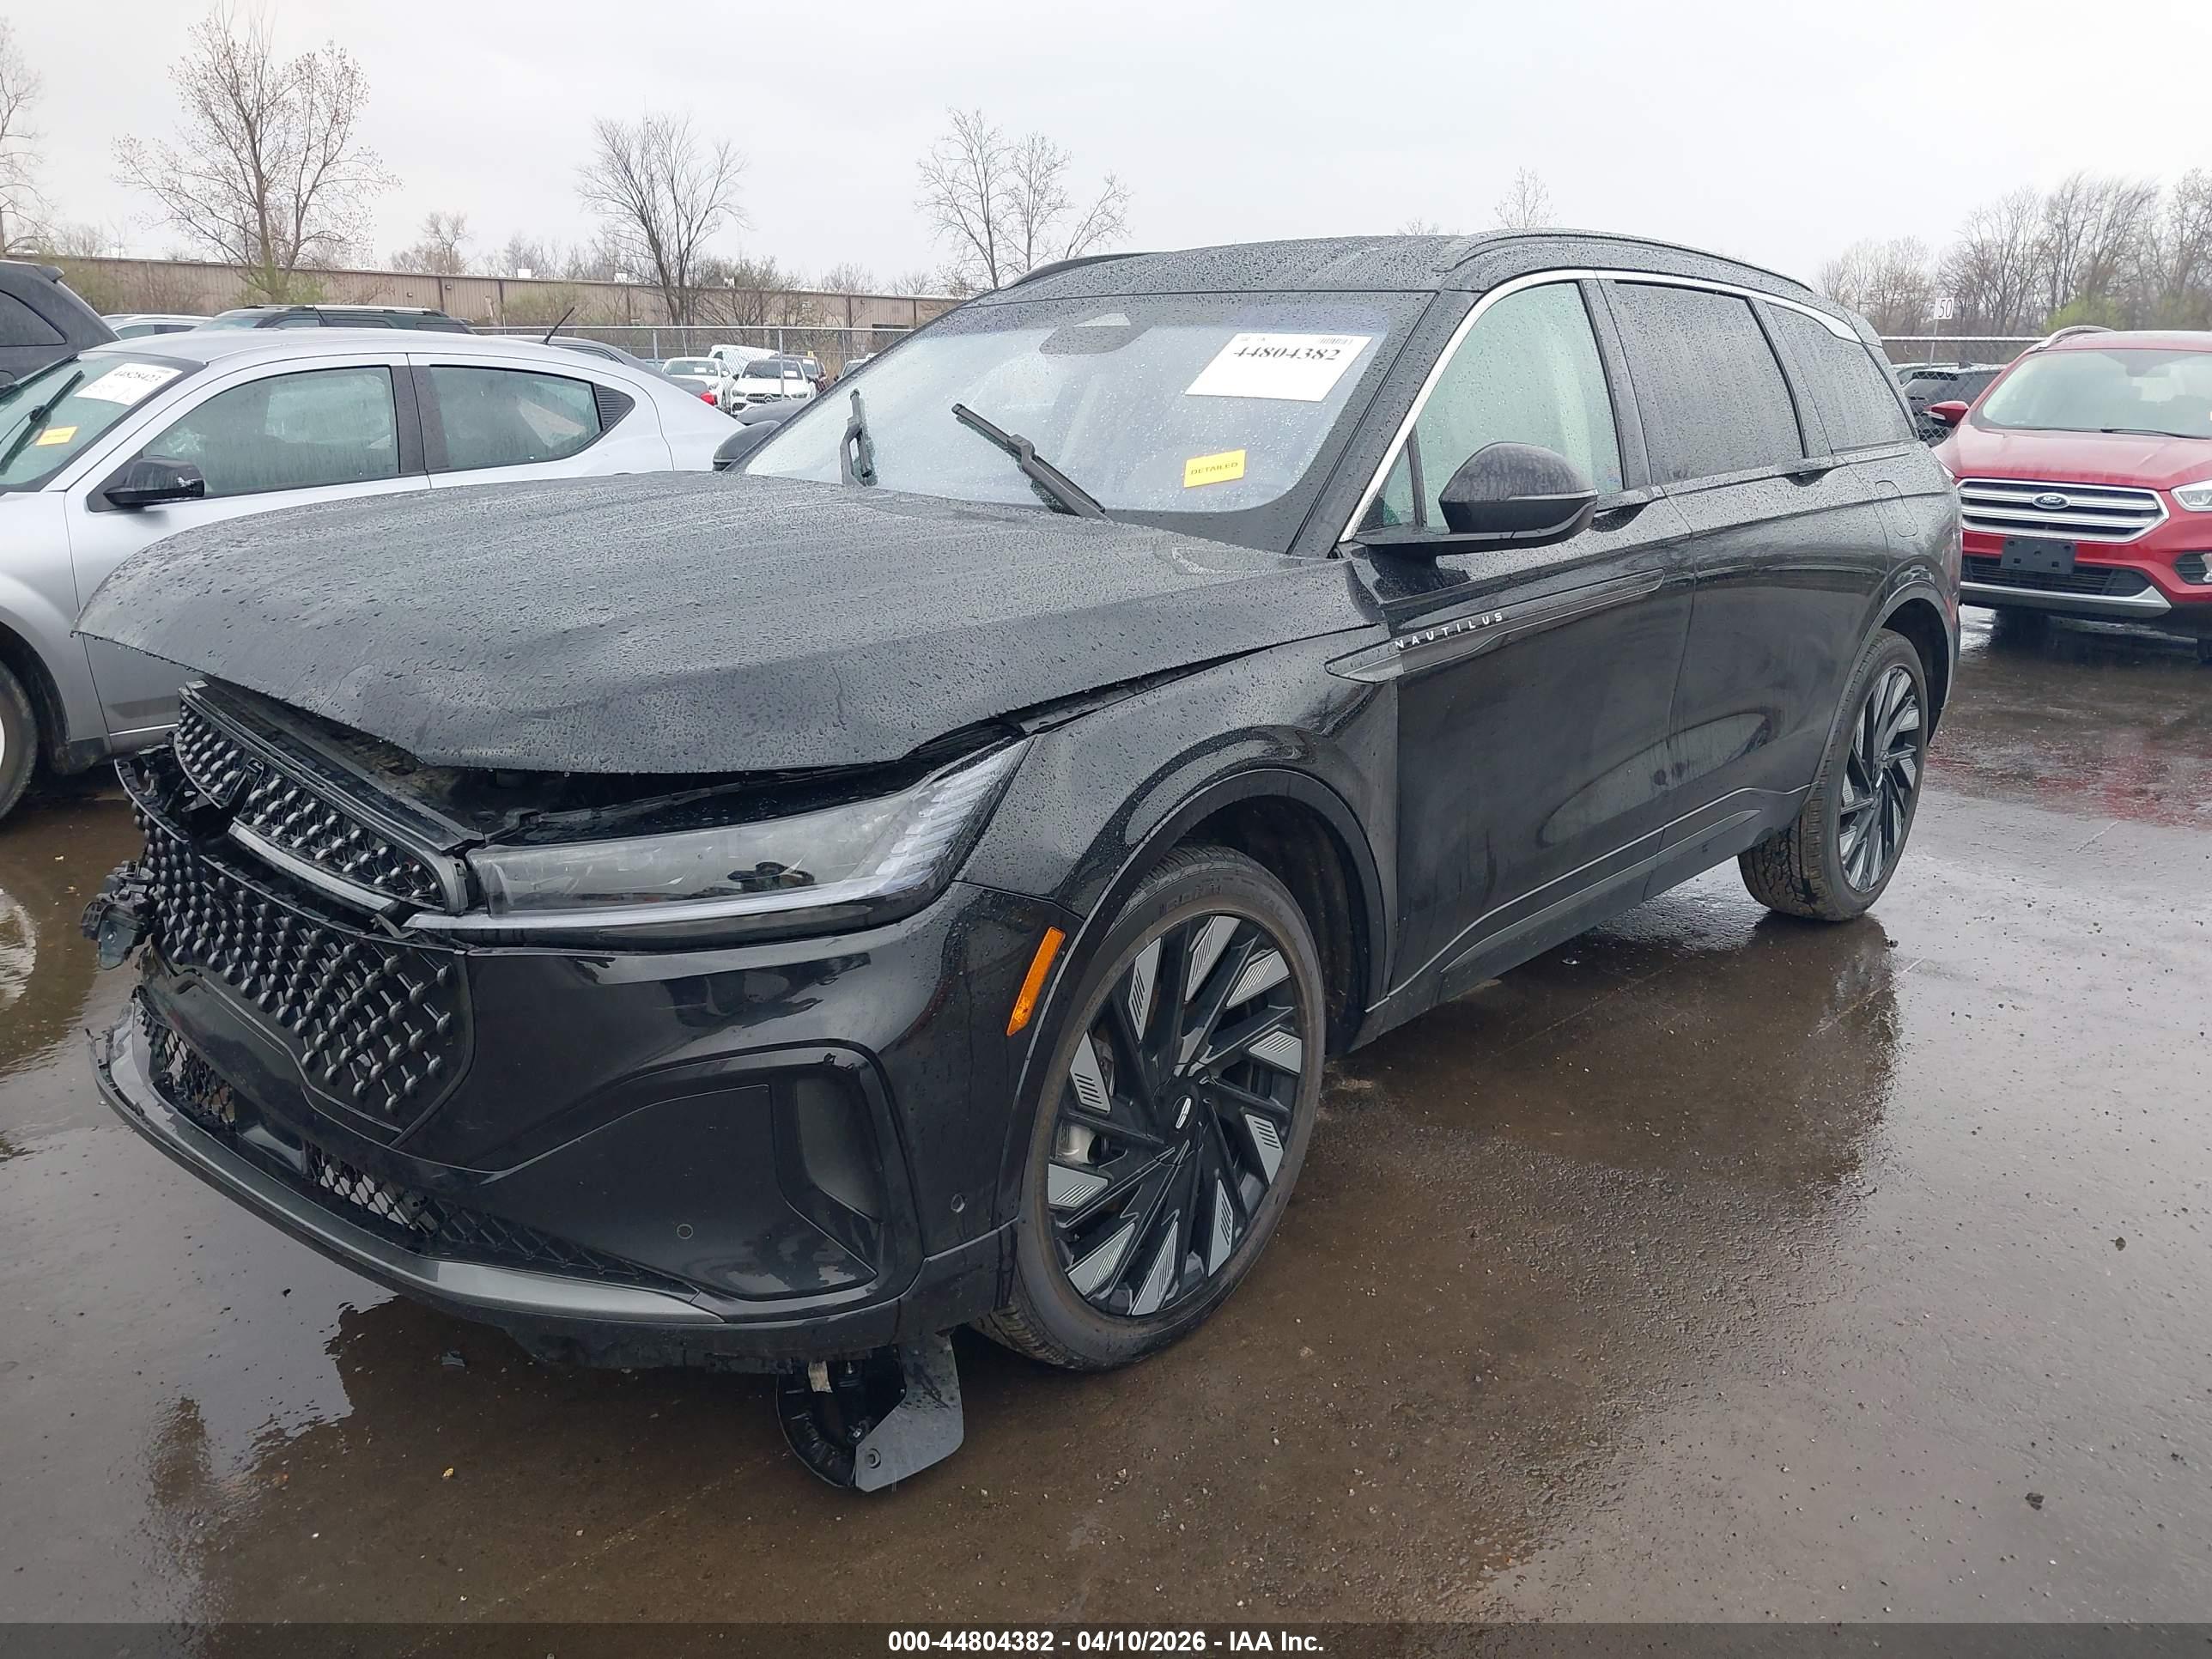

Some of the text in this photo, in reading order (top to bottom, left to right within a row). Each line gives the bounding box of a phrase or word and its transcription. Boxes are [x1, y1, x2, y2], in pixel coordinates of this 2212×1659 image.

[1938, 299, 1953, 318] 50
[1233, 346, 1341, 361] 44804382
[1190, 462, 1238, 475] DETAILED
[1395, 611, 1503, 649] NAUTILUS
